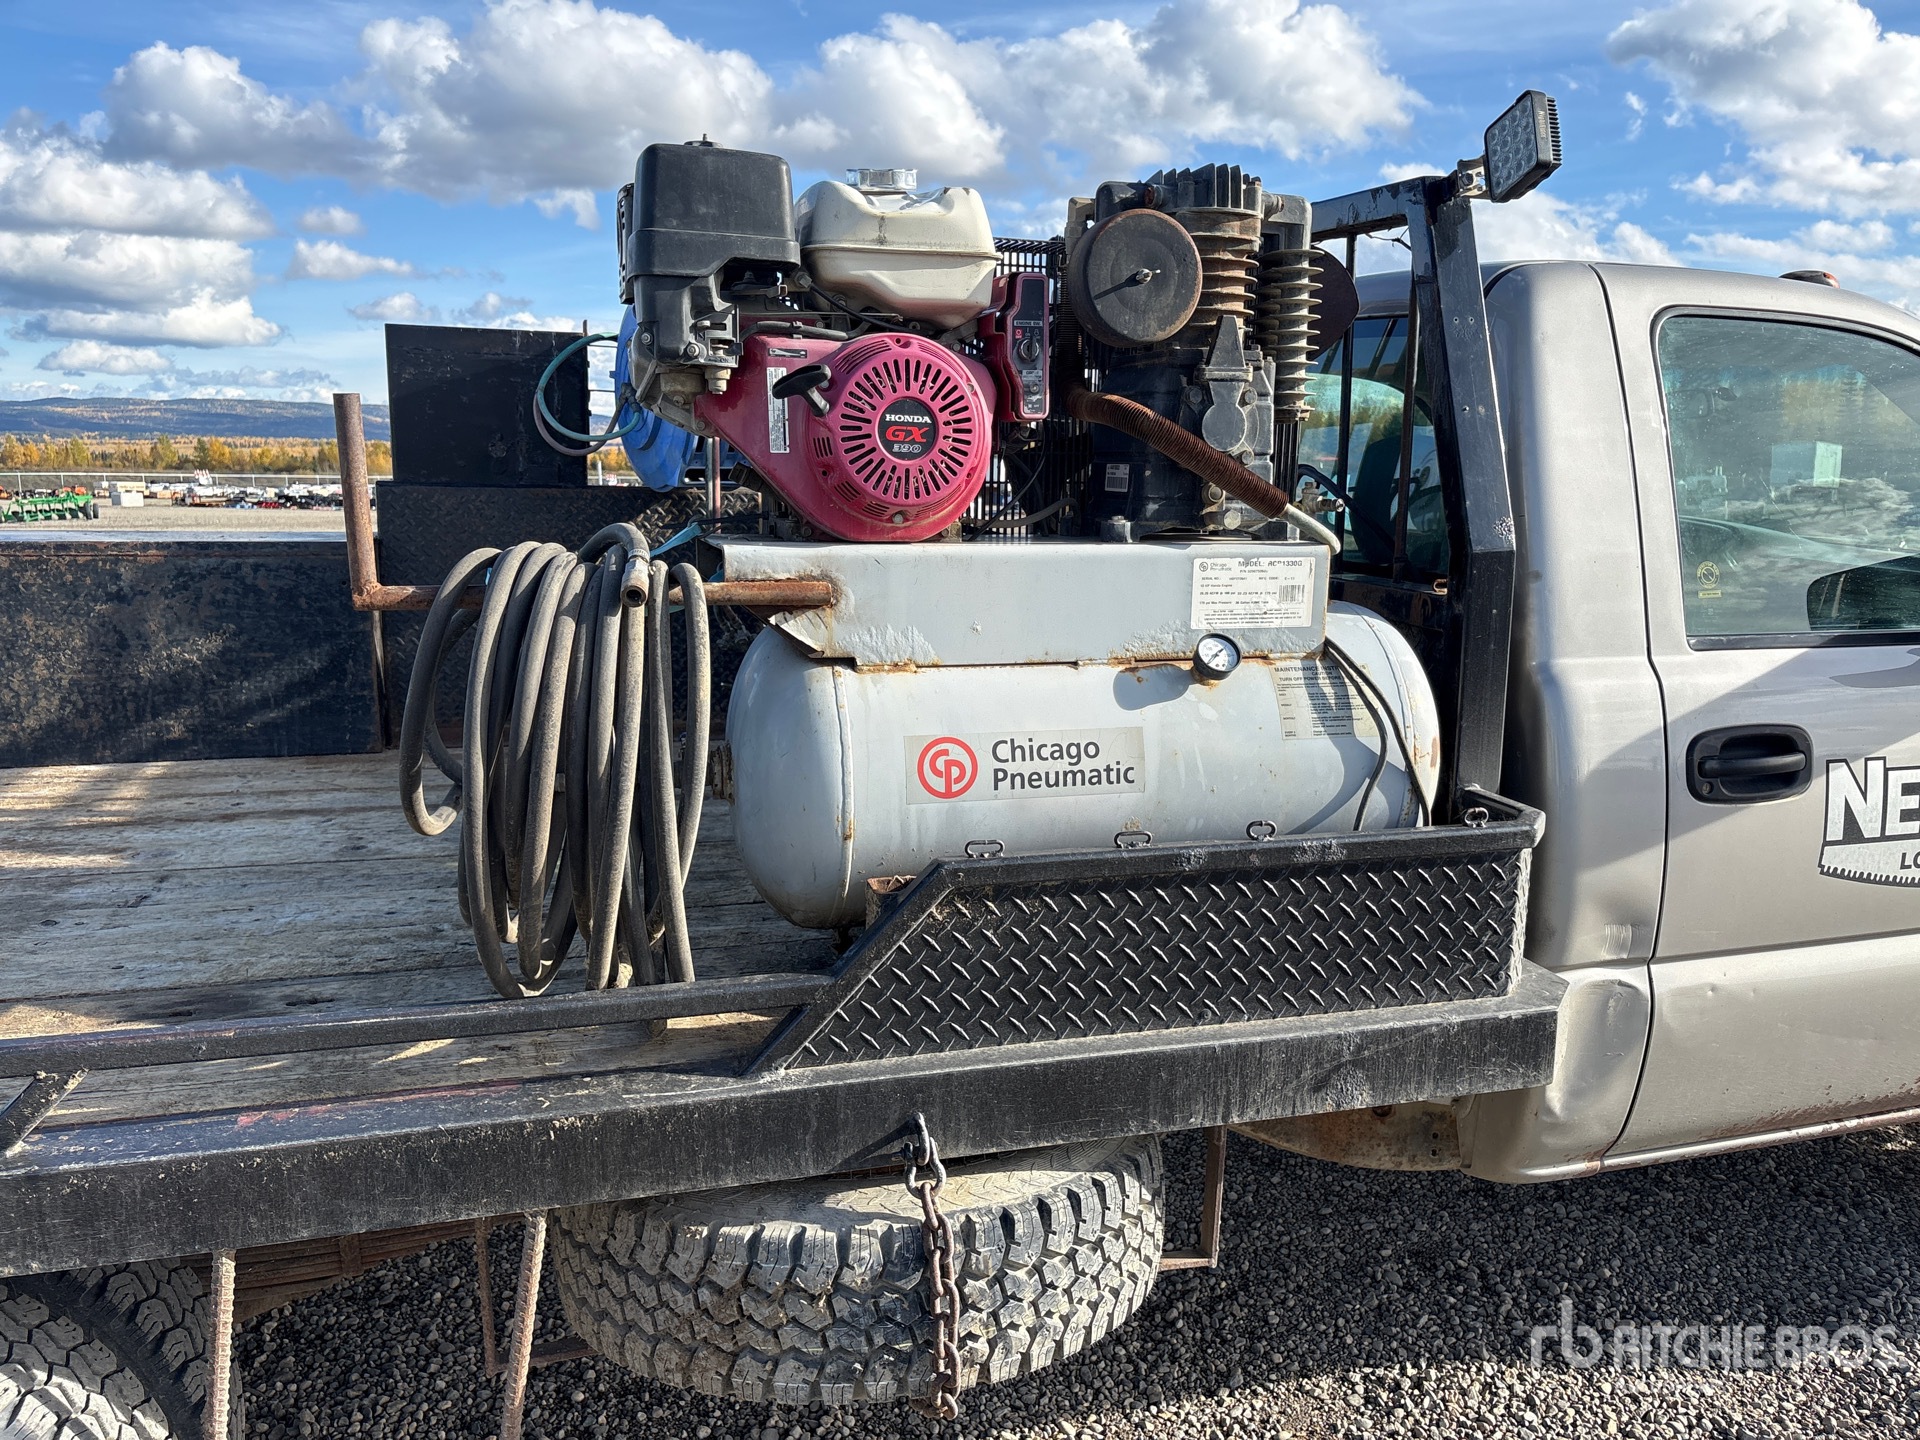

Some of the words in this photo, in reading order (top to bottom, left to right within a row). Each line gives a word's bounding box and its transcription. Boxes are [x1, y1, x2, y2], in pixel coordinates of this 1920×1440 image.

[885, 414, 932, 424] HONDA
[885, 425, 930, 443] GX
[892, 443, 922, 453] 390
[992, 737, 1100, 766] Chicago
[993, 761, 1135, 791] Pneumatic
